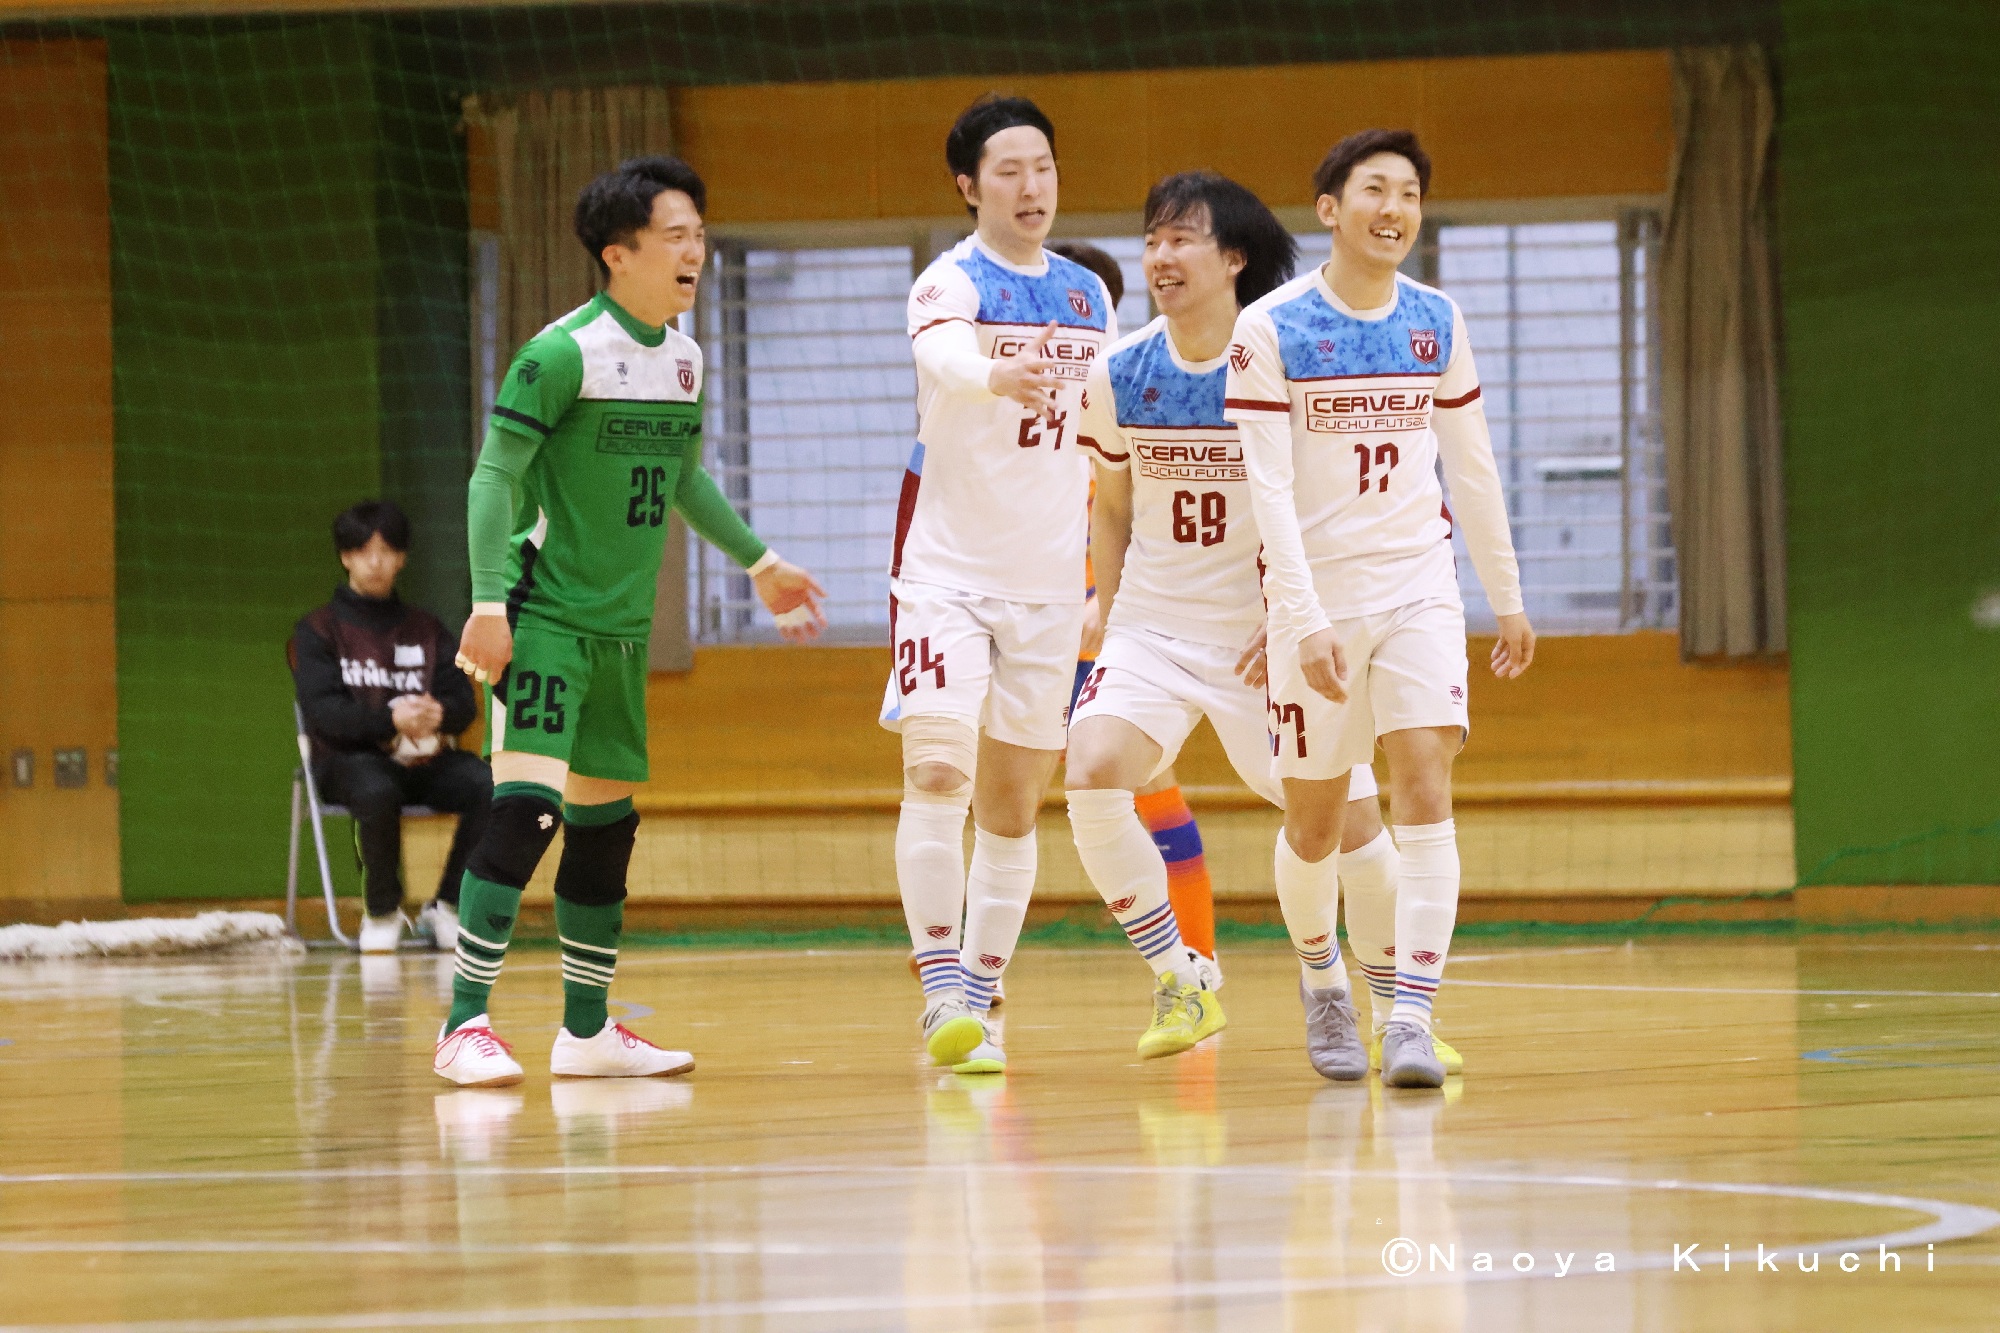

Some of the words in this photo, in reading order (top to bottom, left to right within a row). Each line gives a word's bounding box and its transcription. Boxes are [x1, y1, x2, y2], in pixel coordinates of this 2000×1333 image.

[1312, 394, 1430, 413] CERVEJA
[607, 419, 690, 437] CERVEJA
[1315, 419, 1369, 430] FUCHU
[1136, 445, 1244, 462] CERVEJ
[1140, 464, 1190, 477] FUCHU
[627, 466, 666, 527] 25
[1172, 490, 1227, 547] 69
[899, 637, 946, 696] 24
[513, 670, 567, 735] 25
